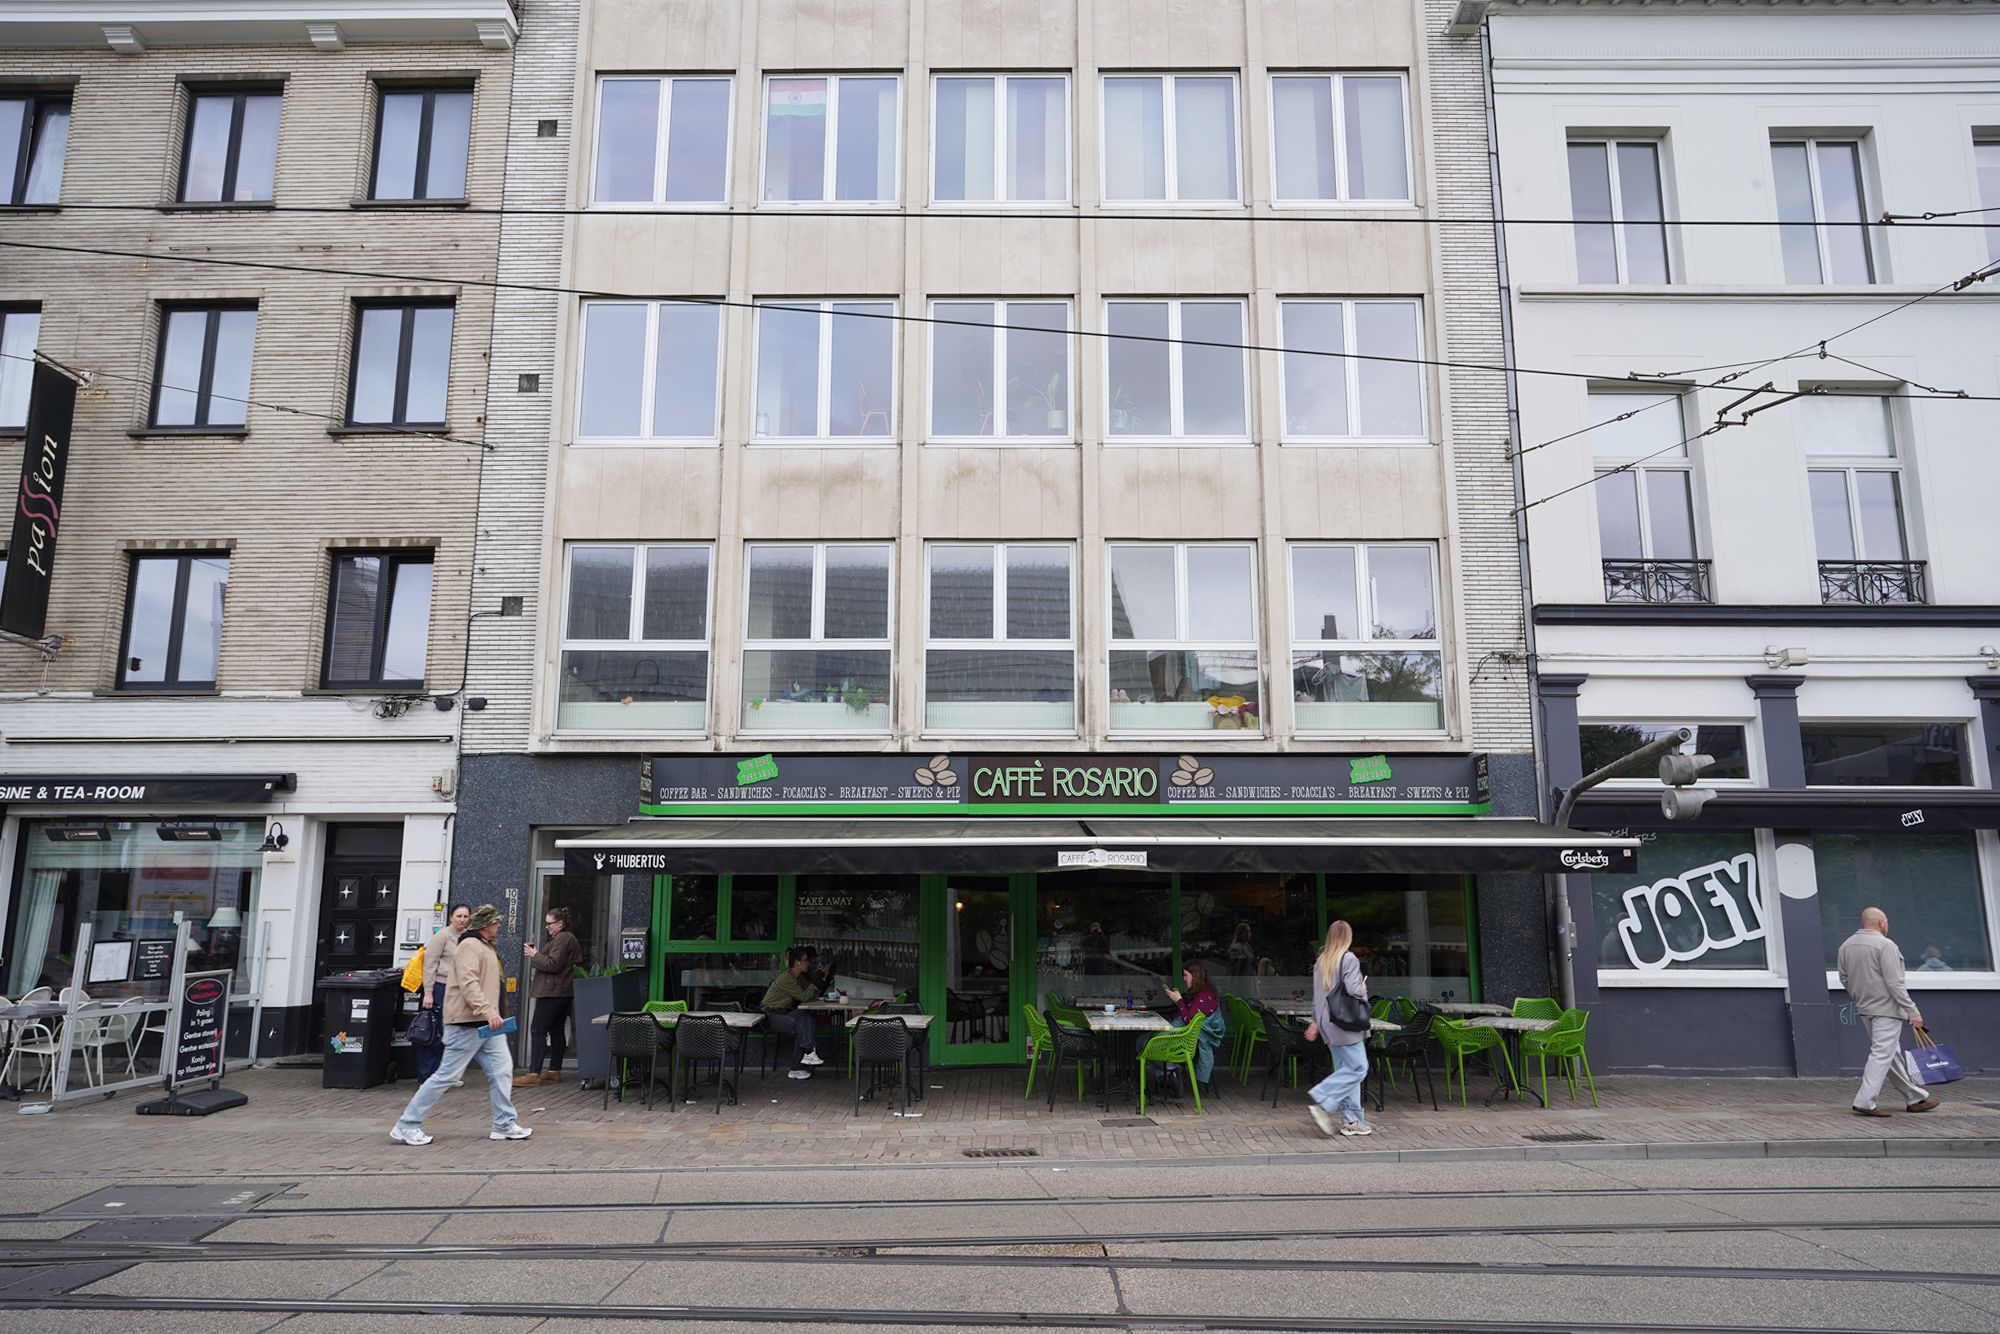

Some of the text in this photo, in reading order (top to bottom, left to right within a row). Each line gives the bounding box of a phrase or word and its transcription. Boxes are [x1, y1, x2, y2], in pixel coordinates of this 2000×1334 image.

[974, 759, 1158, 797] CAFFÈ ROSARIO
[36, 786, 48, 799] &
[53, 786, 146, 799] TEA-ROOM
[660, 787, 689, 799] COFFEE
[691, 787, 708, 799] BAR
[717, 787, 772, 799] SANDWICHES
[783, 787, 827, 799] FOCACCIA'S
[840, 787, 888, 799] BREAKFAST
[898, 787, 933, 799] SWEETS
[935, 787, 943, 799] &
[946, 787, 961, 799] PIE
[1167, 787, 1197, 799] COFFEE
[1199, 787, 1215, 799] BAR
[1225, 787, 1281, 799] SANDWICHES
[1291, 787, 1335, 799] FOCACCIA'S
[1349, 787, 1396, 799] BREAKFAST
[1407, 787, 1442, 799] SWEETS
[1444, 787, 1452, 799] &
[1455, 787, 1470, 799] PIE
[1901, 809, 1925, 827] JOEY
[616, 854, 666, 868] HUBERTUS
[1107, 854, 1146, 865] ROSARIO
[1560, 849, 1609, 869] Carlsberg
[507, 888, 518, 898] 10
[510, 898, 517, 907] 9
[799, 896, 853, 906] TAKE AWAY
[509, 906, 516, 915] 8
[1618, 853, 1766, 970] JOEY
